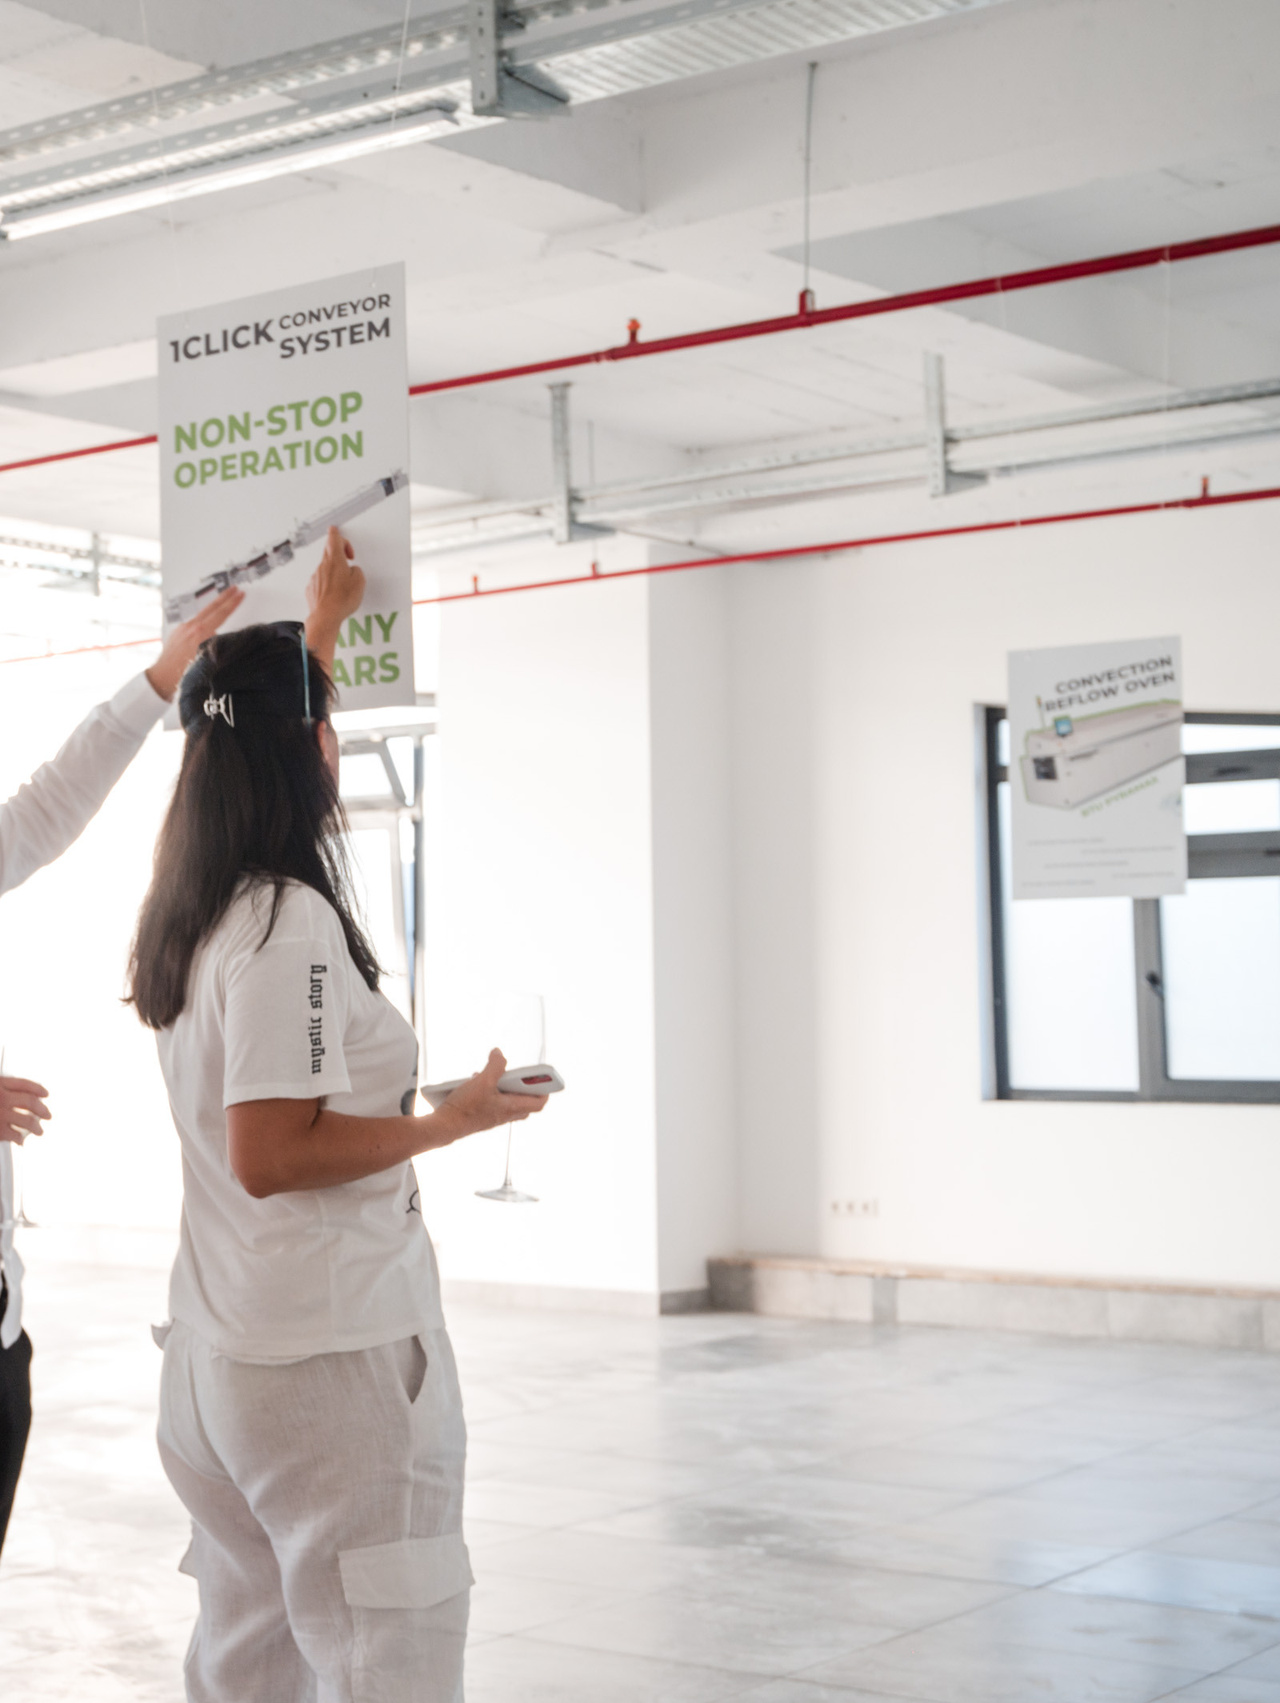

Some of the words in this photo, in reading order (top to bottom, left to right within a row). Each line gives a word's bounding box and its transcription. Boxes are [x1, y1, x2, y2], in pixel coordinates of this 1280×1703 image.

[279, 294, 391, 329] CONVEYOR
[170, 319, 274, 363] 1CLICK
[280, 317, 391, 359] SYSTEM
[174, 391, 363, 454] NON-STOP
[174, 431, 364, 488] OPERATION
[1045, 685, 1119, 711] REFLOW
[1124, 671, 1176, 693] OVEN
[1055, 655, 1173, 694] CONVECTION
[308, 964, 327, 1009] story
[308, 1017, 325, 1074] mystic
